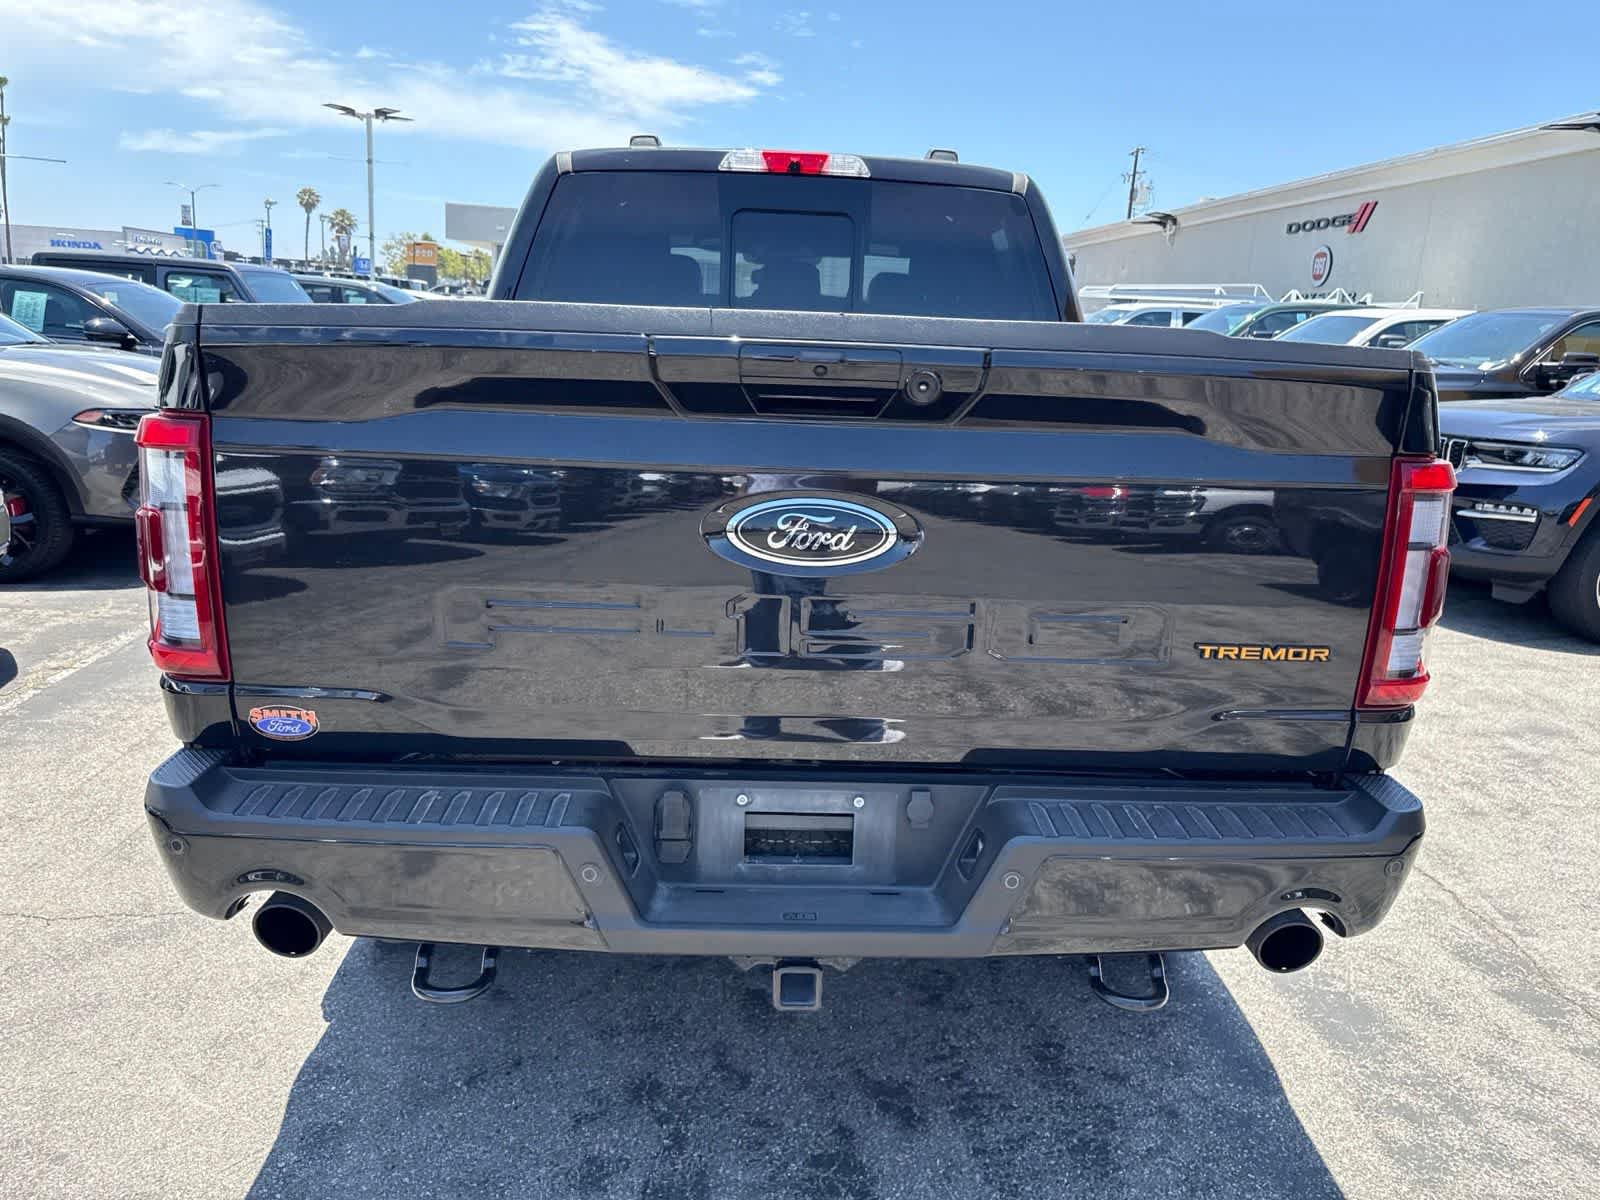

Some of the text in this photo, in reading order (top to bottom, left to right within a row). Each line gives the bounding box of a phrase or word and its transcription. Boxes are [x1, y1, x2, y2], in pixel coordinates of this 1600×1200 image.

[1287, 213, 1357, 233] DODGE
[50, 239, 102, 250] HONDA
[766, 512, 858, 551] Ford
[1195, 643, 1331, 662] TREMOR
[250, 708, 316, 727] SMITH
[267, 719, 301, 733] Ford
